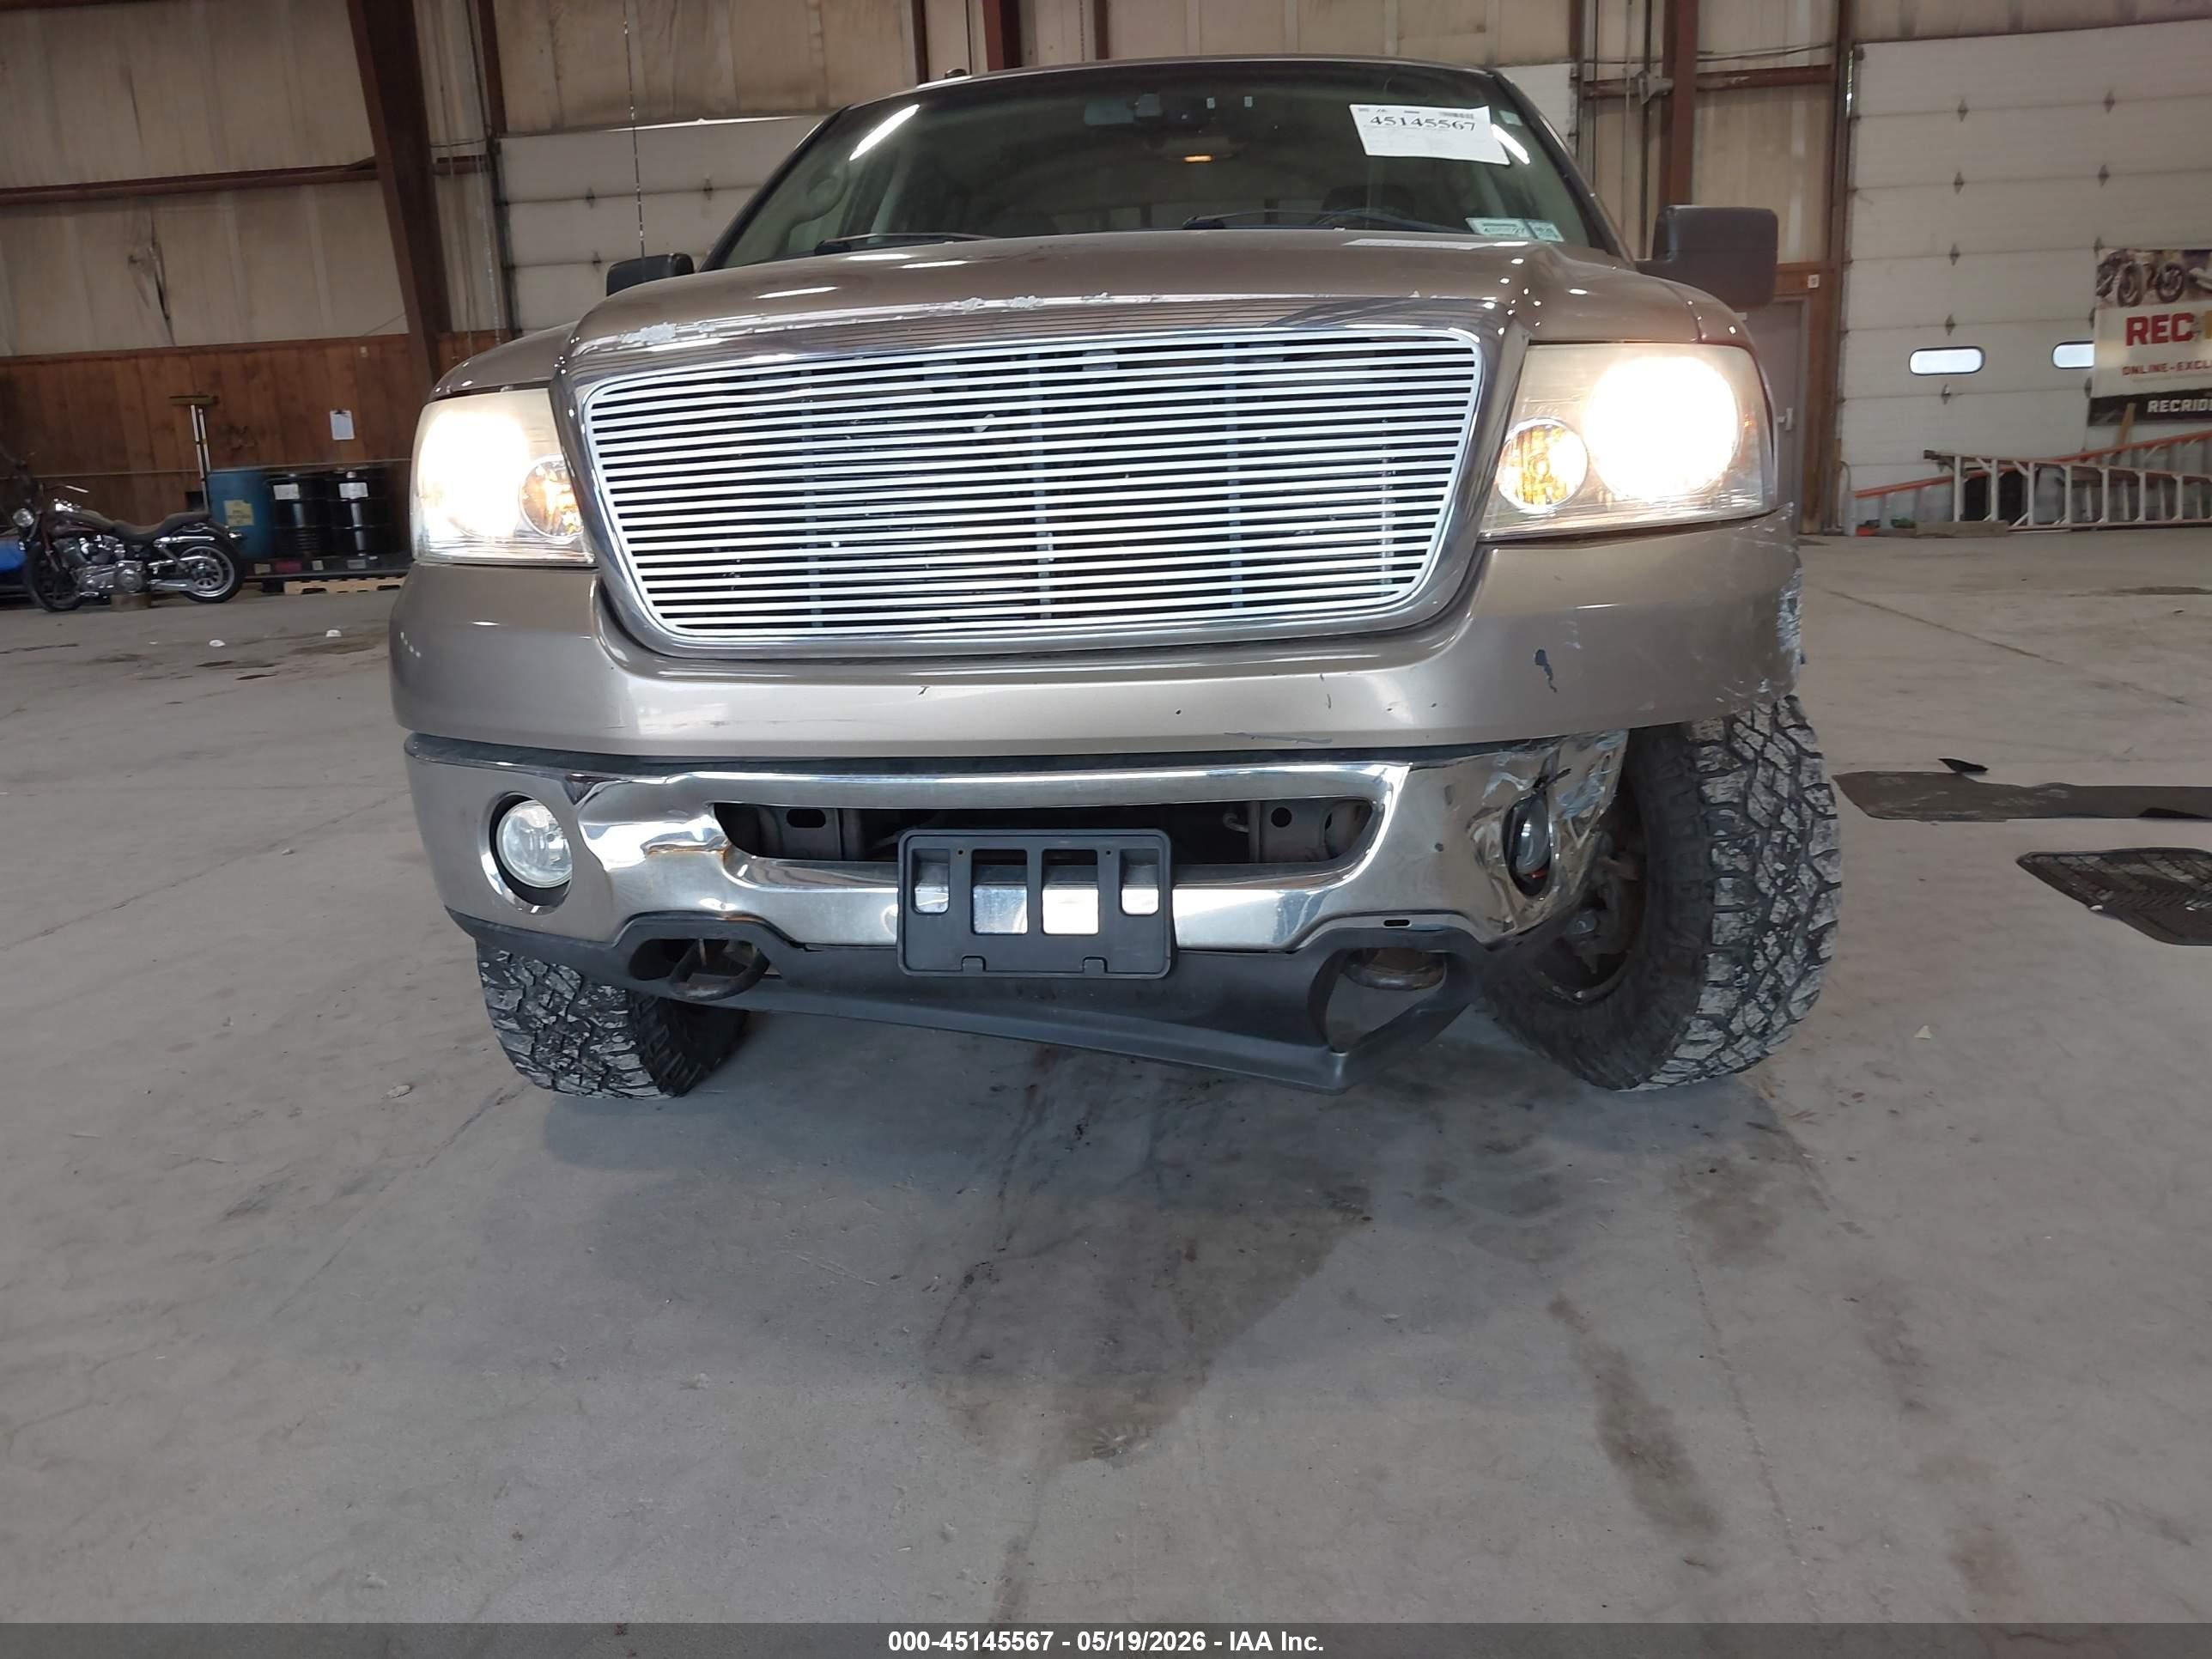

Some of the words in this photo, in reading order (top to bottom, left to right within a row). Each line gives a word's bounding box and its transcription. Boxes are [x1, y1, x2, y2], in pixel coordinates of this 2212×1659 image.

[1370, 115, 1476, 131] 45145567
[2125, 312, 2195, 347] REC
[2122, 359, 2212, 376] ONLINE-EXCL
